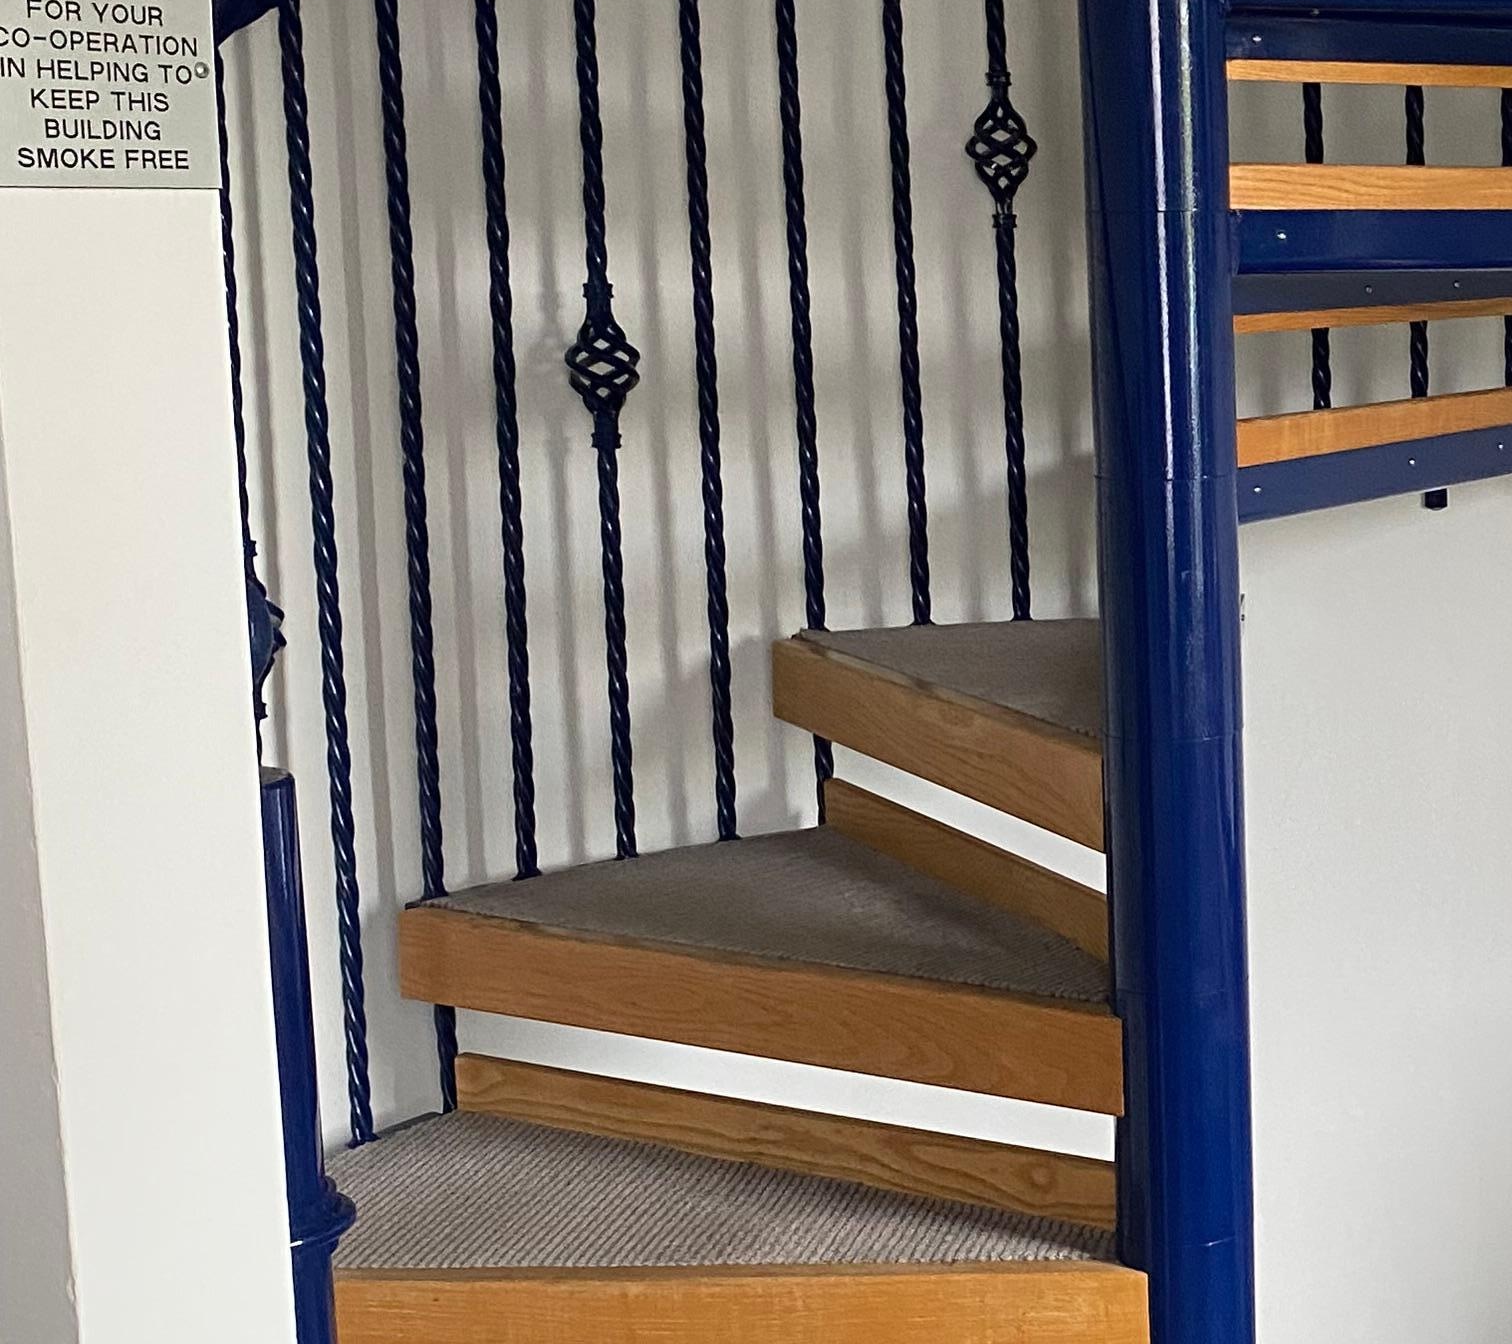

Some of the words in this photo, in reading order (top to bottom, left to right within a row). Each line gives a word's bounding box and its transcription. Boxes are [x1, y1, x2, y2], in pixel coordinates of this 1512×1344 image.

[91, 2, 163, 26] YOUR
[37, 59, 148, 83] HELPING
[158, 64, 192, 84] TO
[30, 88, 100, 110] KEEP
[111, 91, 169, 112] THIS
[45, 118, 161, 141] BUILDING
[18, 147, 115, 169] SMOKE
[125, 150, 189, 170] FREE
